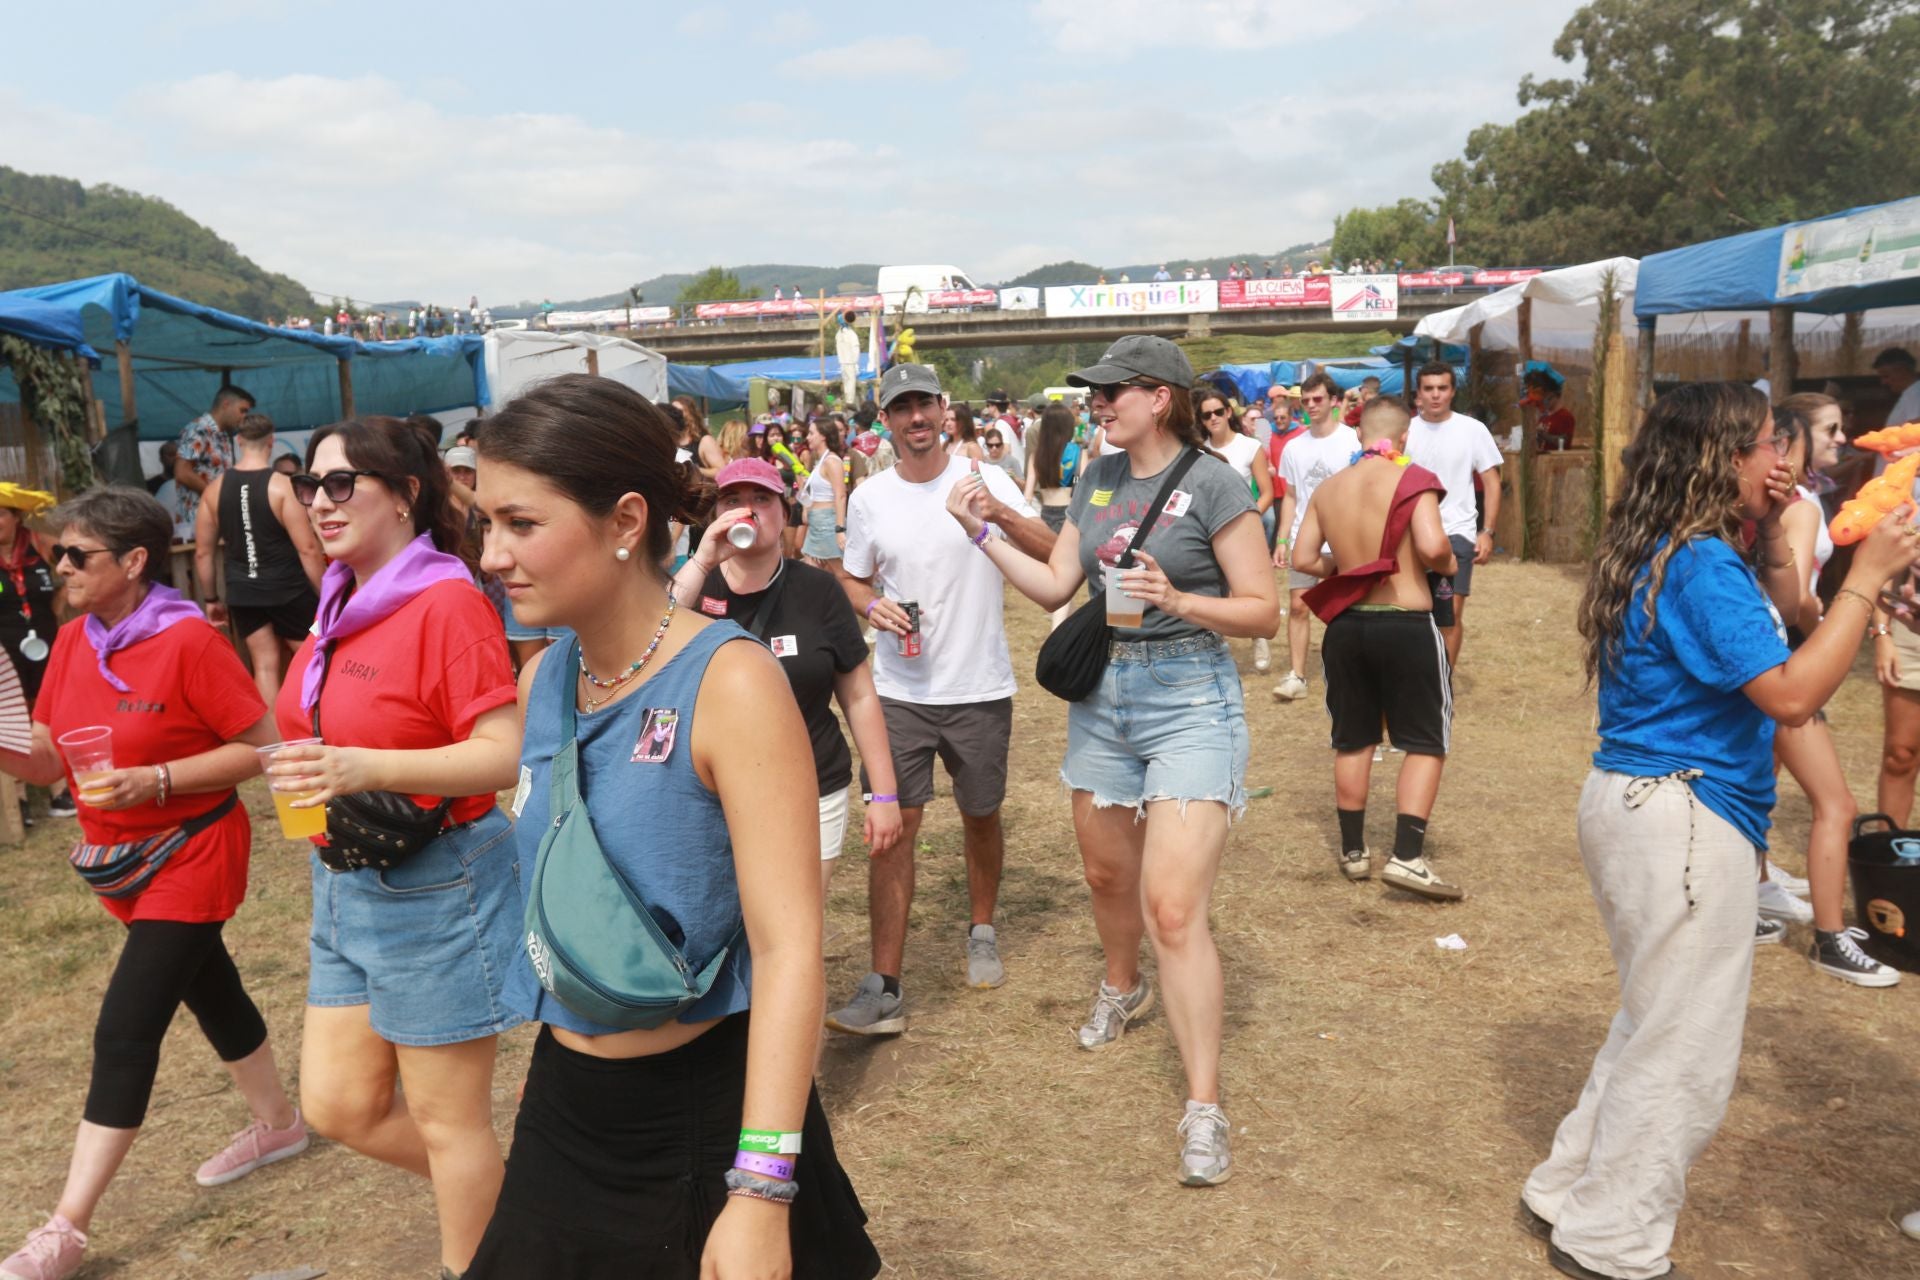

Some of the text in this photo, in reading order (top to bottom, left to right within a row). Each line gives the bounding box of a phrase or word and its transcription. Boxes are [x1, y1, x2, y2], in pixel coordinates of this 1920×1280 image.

[1069, 284, 1201, 312] Xiringüelu
[1247, 282, 1263, 294] LA
[1266, 280, 1303, 293] CUEVA
[1365, 298, 1396, 309] KELY
[240, 484, 252, 530] UNDER
[340, 659, 380, 682] SARAY
